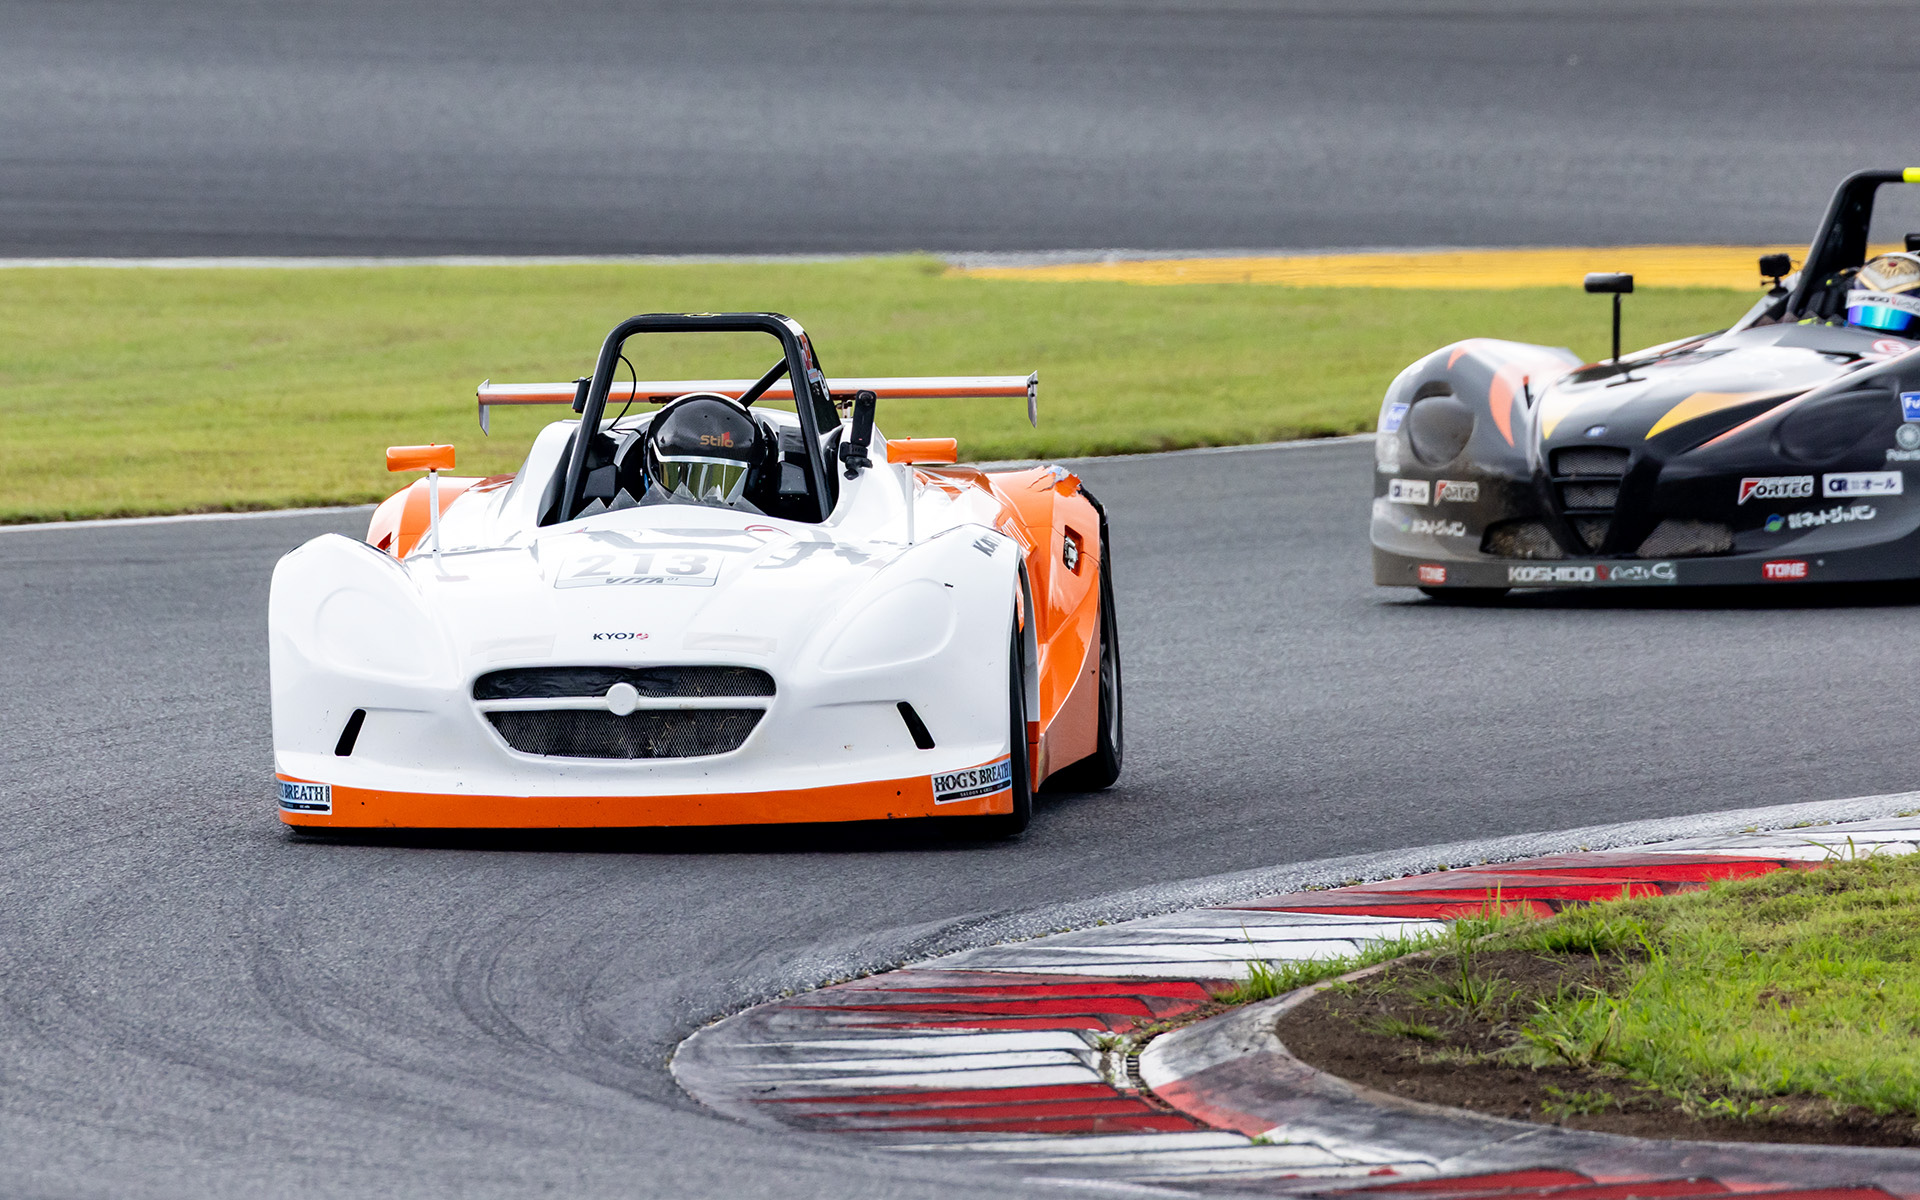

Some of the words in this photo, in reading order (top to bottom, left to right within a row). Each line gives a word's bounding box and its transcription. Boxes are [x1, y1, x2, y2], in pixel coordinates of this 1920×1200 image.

[700, 431, 734, 448] Stilo
[571, 553, 710, 578] 213
[1765, 563, 1806, 578] TONE
[934, 771, 978, 792] HOG'S
[979, 762, 1009, 785] BREATH
[284, 784, 325, 801] BREATH
